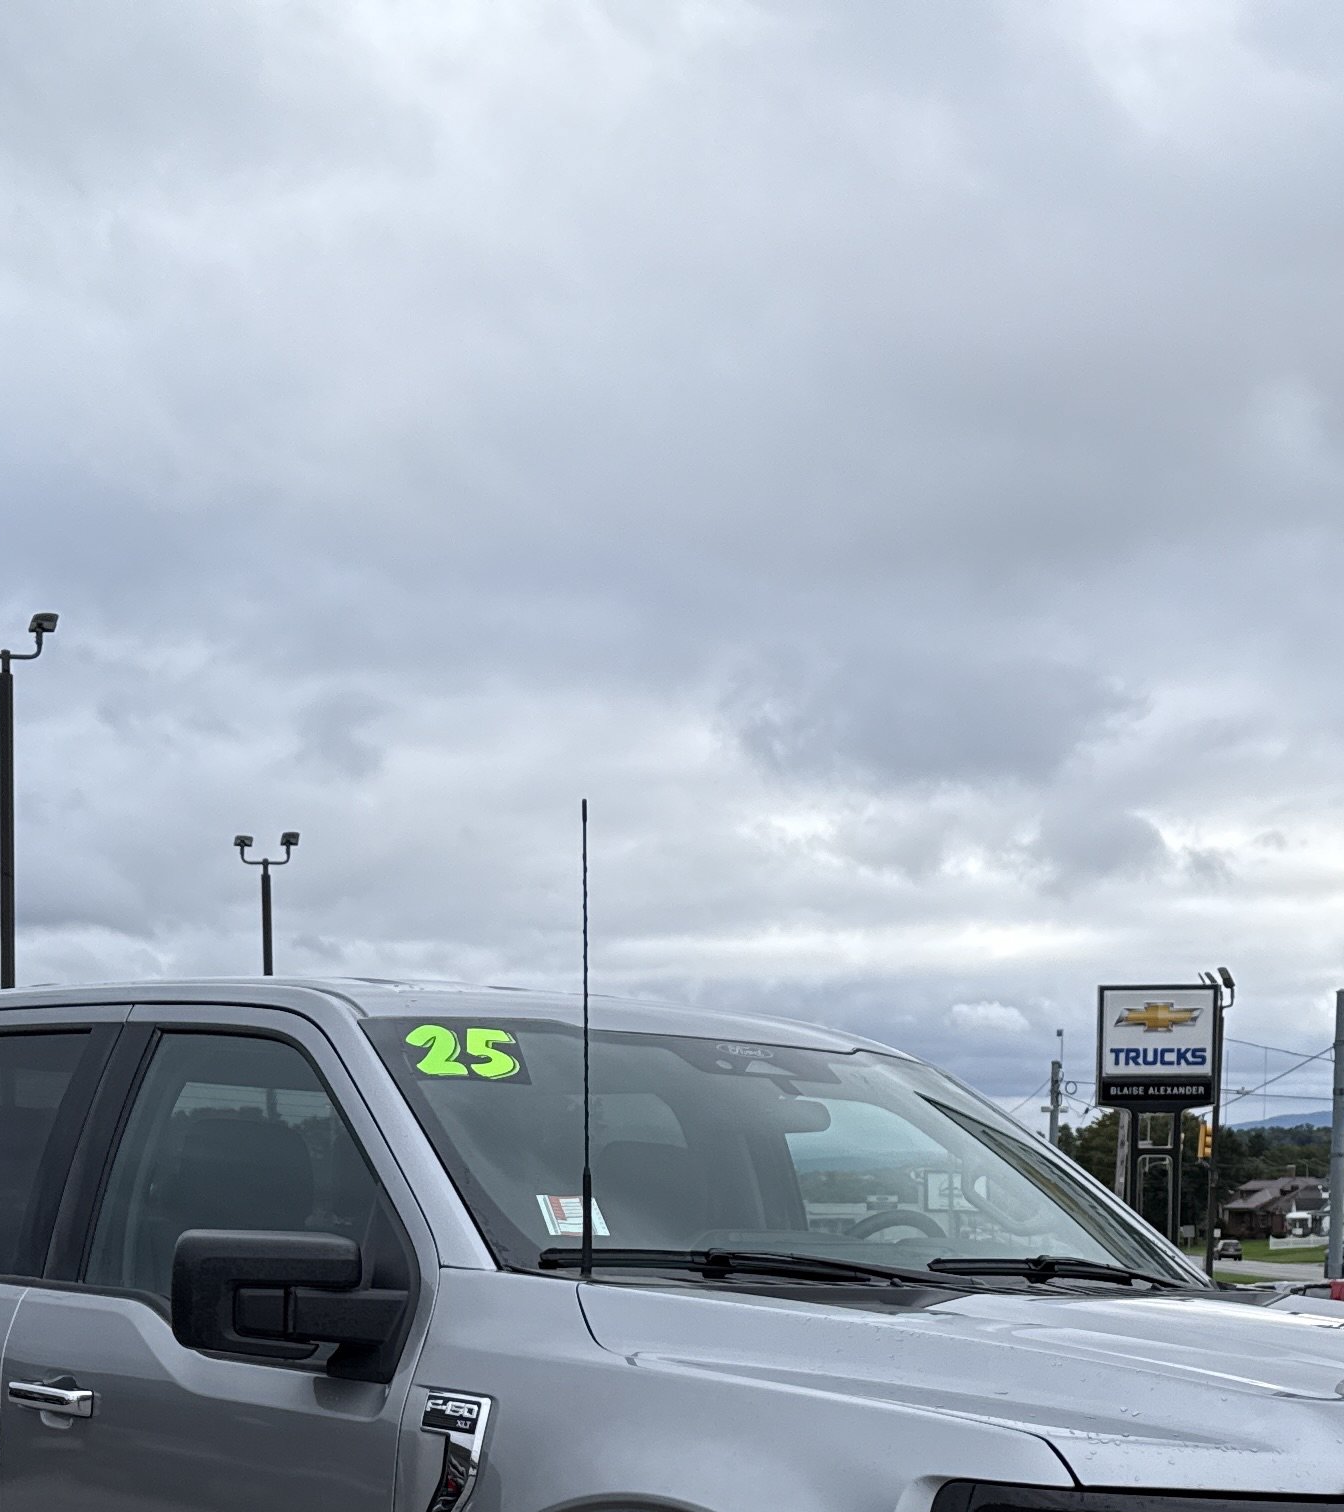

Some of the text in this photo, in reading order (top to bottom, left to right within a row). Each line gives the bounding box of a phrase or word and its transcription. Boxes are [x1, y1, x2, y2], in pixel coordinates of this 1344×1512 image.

[405, 1024, 521, 1080] 25
[1110, 1047, 1207, 1066] TRUCKS
[1110, 1086, 1205, 1096] BLAISE ALEXANDER
